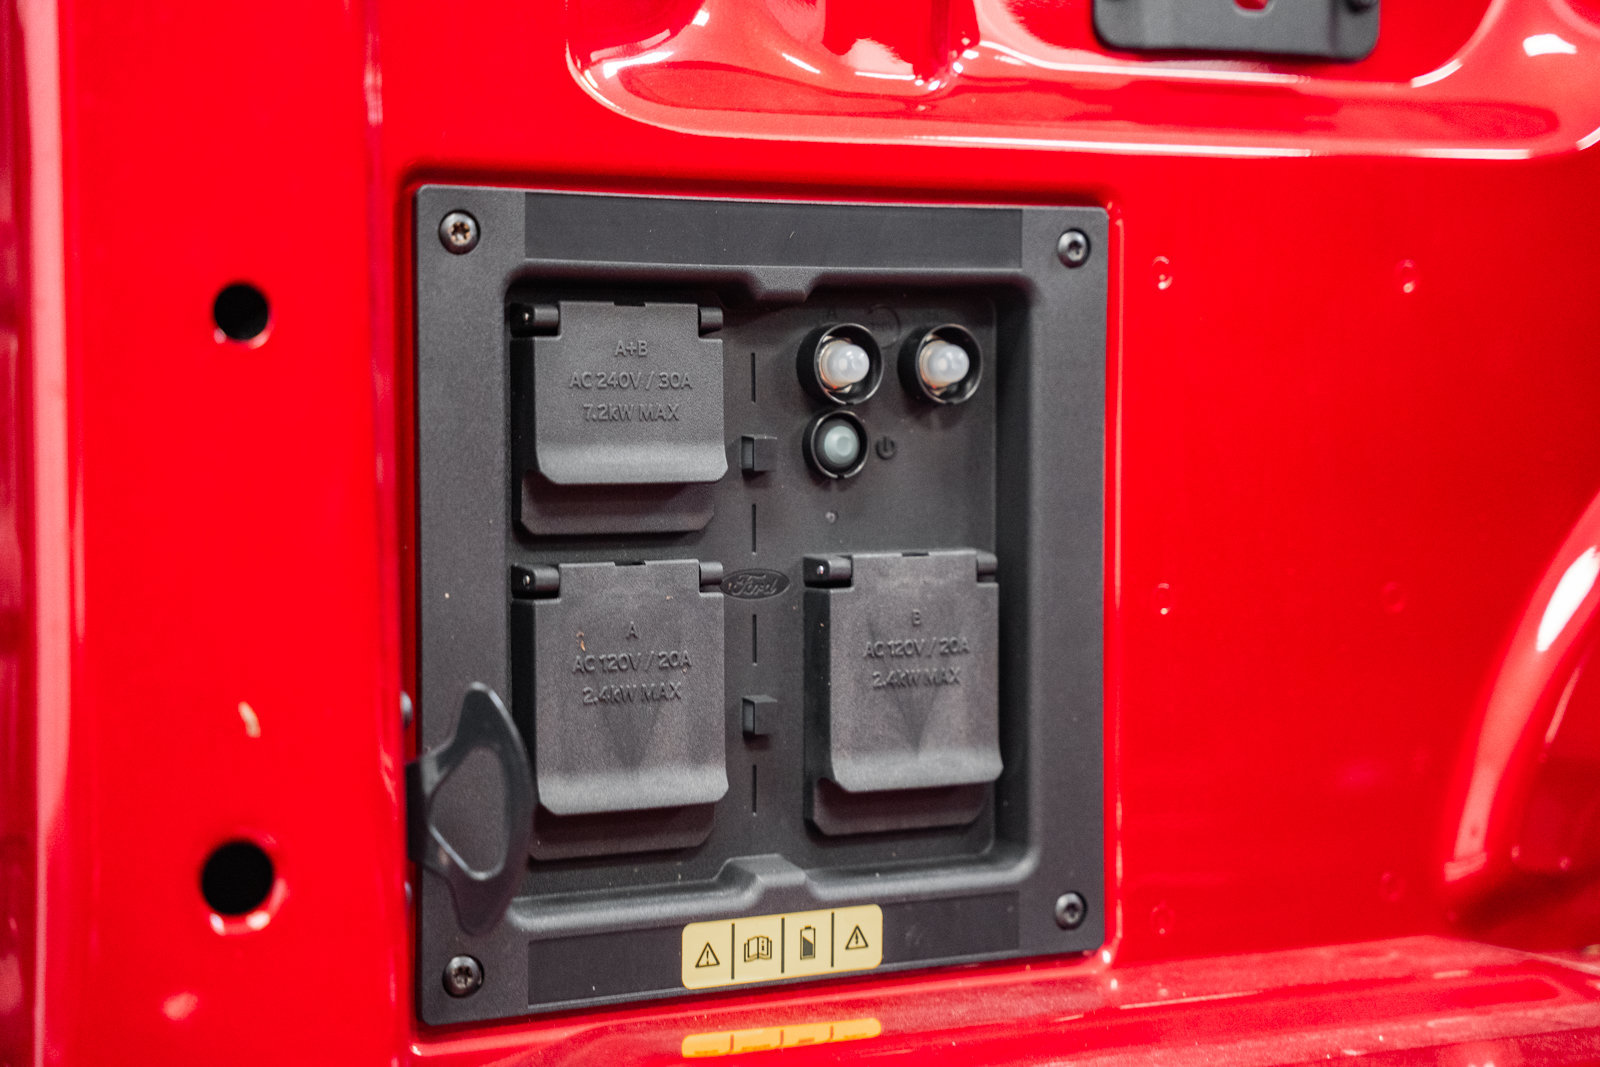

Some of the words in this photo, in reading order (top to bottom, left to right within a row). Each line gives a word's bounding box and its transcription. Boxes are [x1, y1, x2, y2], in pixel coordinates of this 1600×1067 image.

[614, 340, 648, 358] A+B
[569, 371, 593, 389] AC
[596, 371, 642, 389] 240V
[645, 371, 655, 390] /
[658, 371, 693, 389] 30A
[583, 403, 635, 422] 7.2kW
[638, 403, 680, 421] MAX
[731, 573, 778, 596] Ford
[911, 608, 921, 627] B
[626, 620, 639, 640] A
[863, 640, 885, 659] AC
[887, 638, 926, 658] 120V
[927, 636, 937, 658] /
[939, 636, 971, 655] 20A
[571, 654, 596, 674] AC
[599, 652, 642, 673] 120V
[645, 650, 655, 673] /
[658, 650, 692, 669] 20A
[872, 668, 921, 690] 2.4kW
[924, 667, 961, 687] MAX
[582, 684, 637, 706] 2.4kW
[641, 681, 682, 701] MAX
